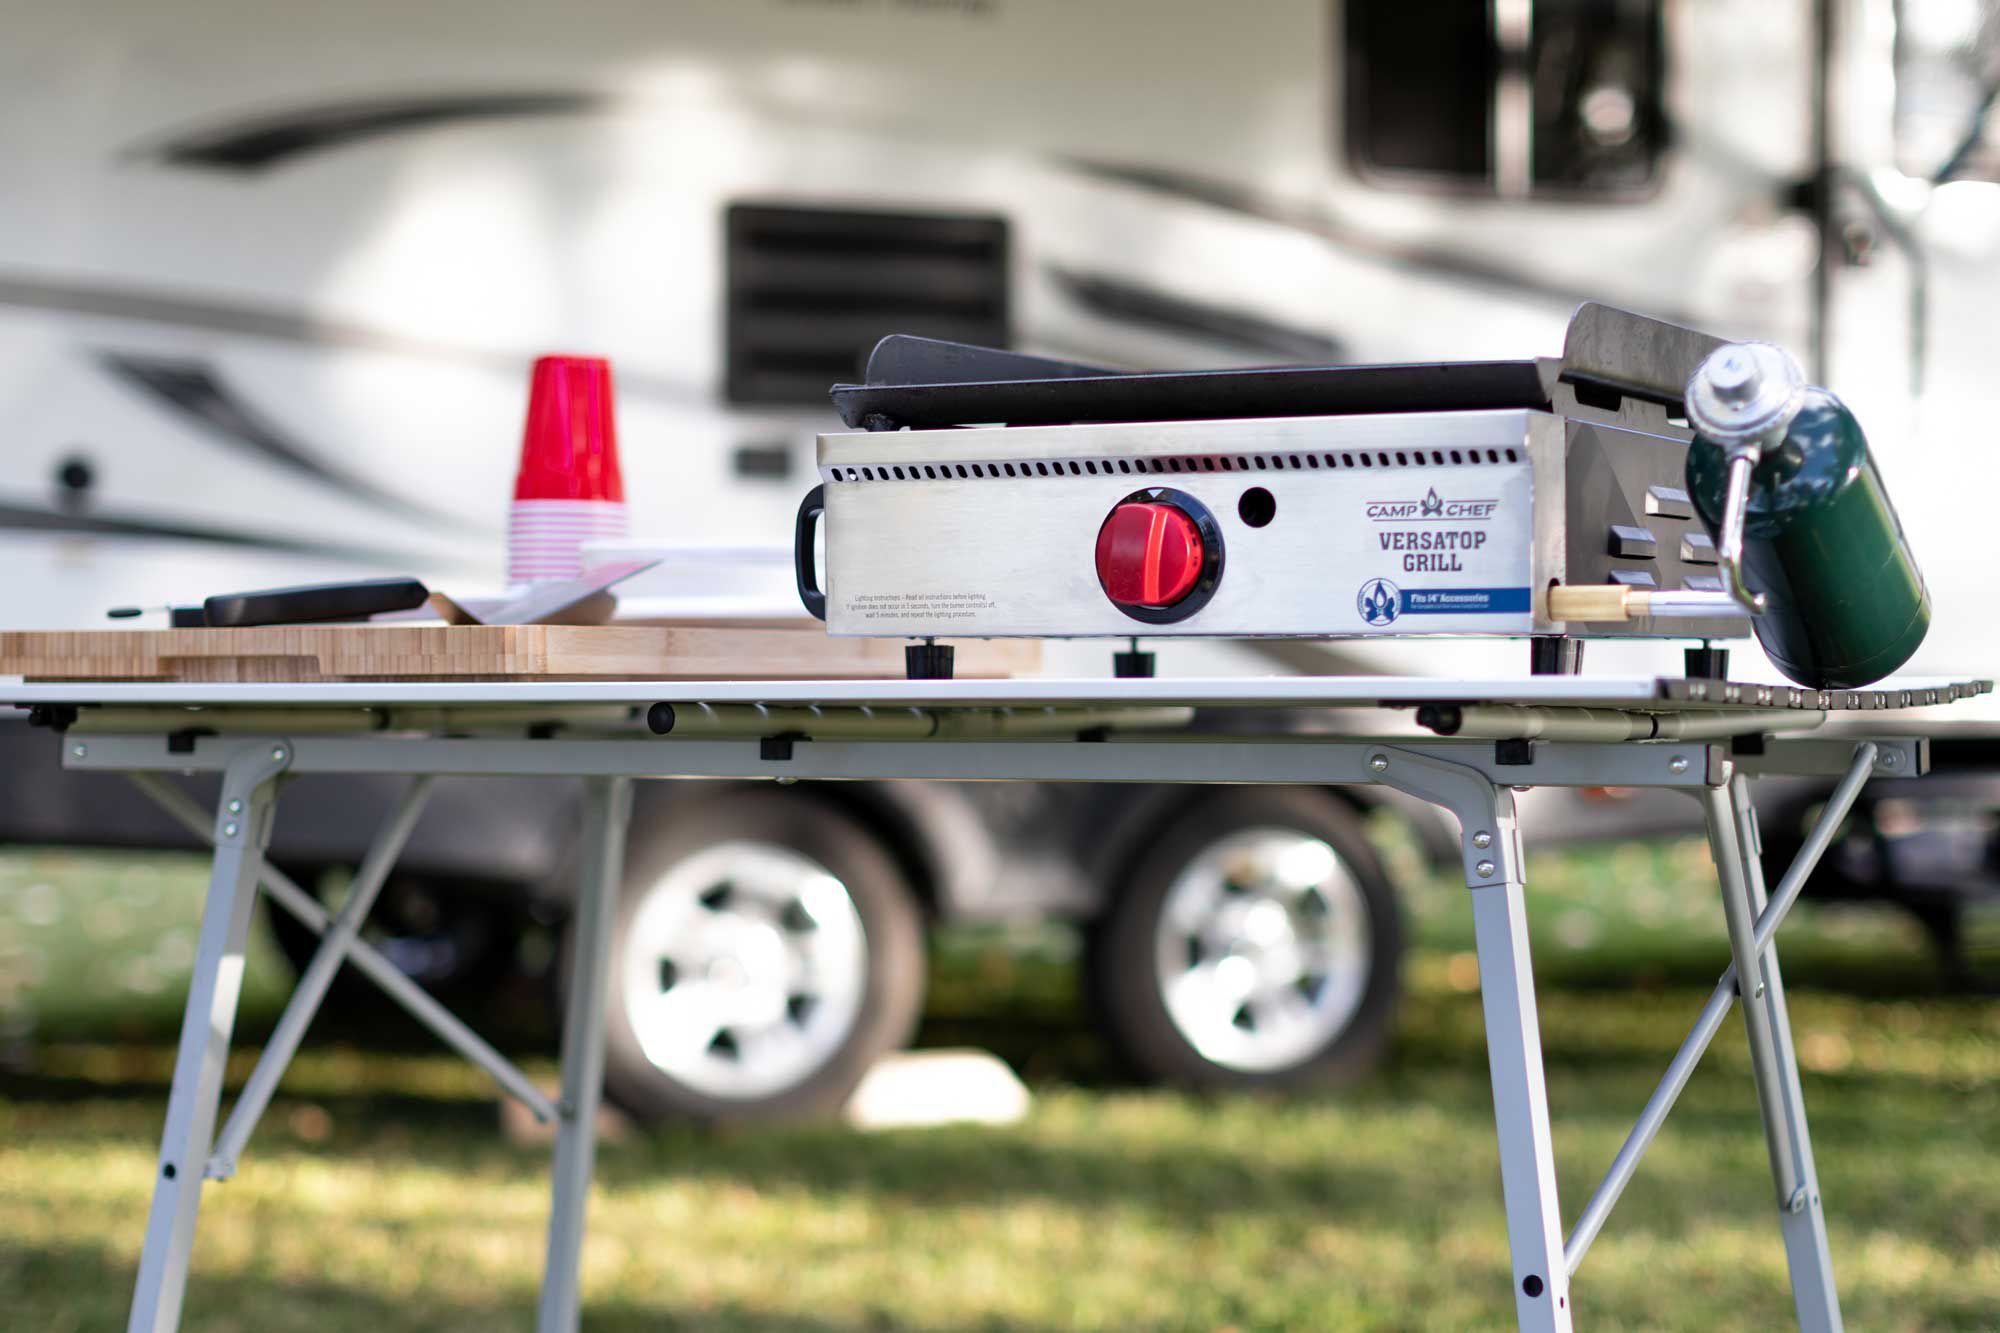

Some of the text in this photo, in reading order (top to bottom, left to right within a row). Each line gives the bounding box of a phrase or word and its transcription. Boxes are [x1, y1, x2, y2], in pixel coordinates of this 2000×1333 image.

[1366, 504, 1497, 518] CAMP CHEF
[1379, 531, 1487, 550] VERSATOP
[1403, 553, 1463, 572] GRILL
[1410, 594, 1427, 603] Fits
[1440, 593, 1490, 603] Accessories
